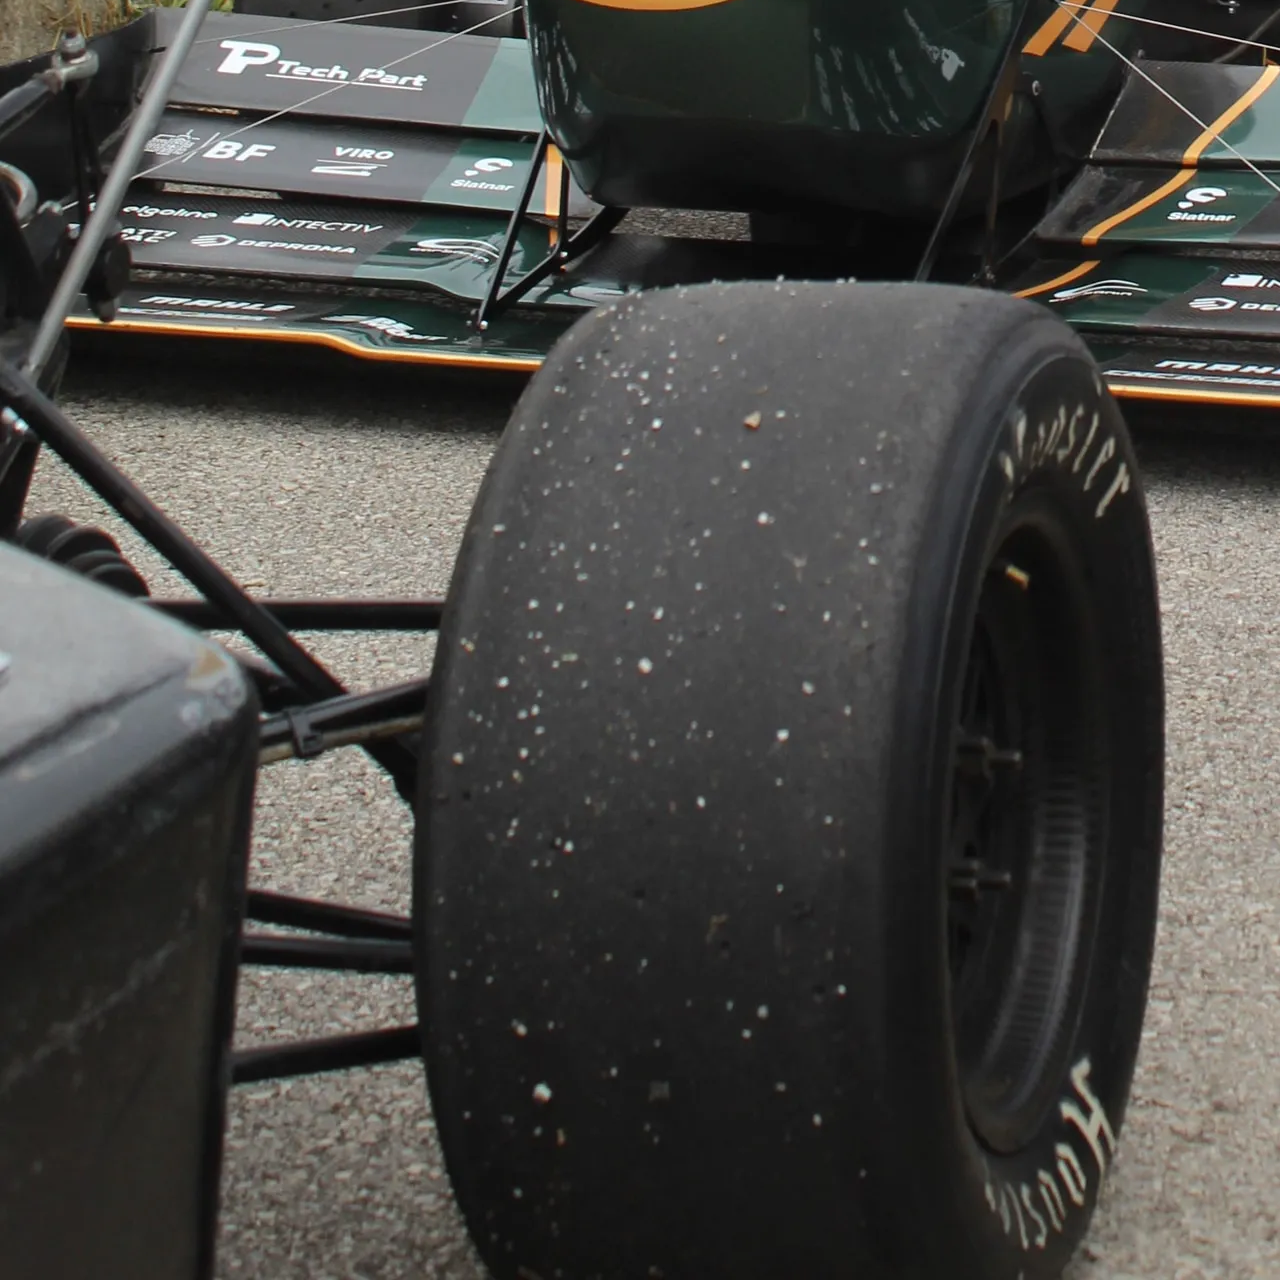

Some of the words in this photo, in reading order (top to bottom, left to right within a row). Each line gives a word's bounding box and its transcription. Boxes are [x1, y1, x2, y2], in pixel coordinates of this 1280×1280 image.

[277, 60, 350, 80] Tech
[358, 68, 428, 87] Part
[203, 140, 277, 162] BF
[334, 146, 395, 161] VIRO
[1167, 211, 1237, 223] Slatnar
[237, 240, 357, 254] DEPROMA
[139, 296, 296, 312] MAHLE
